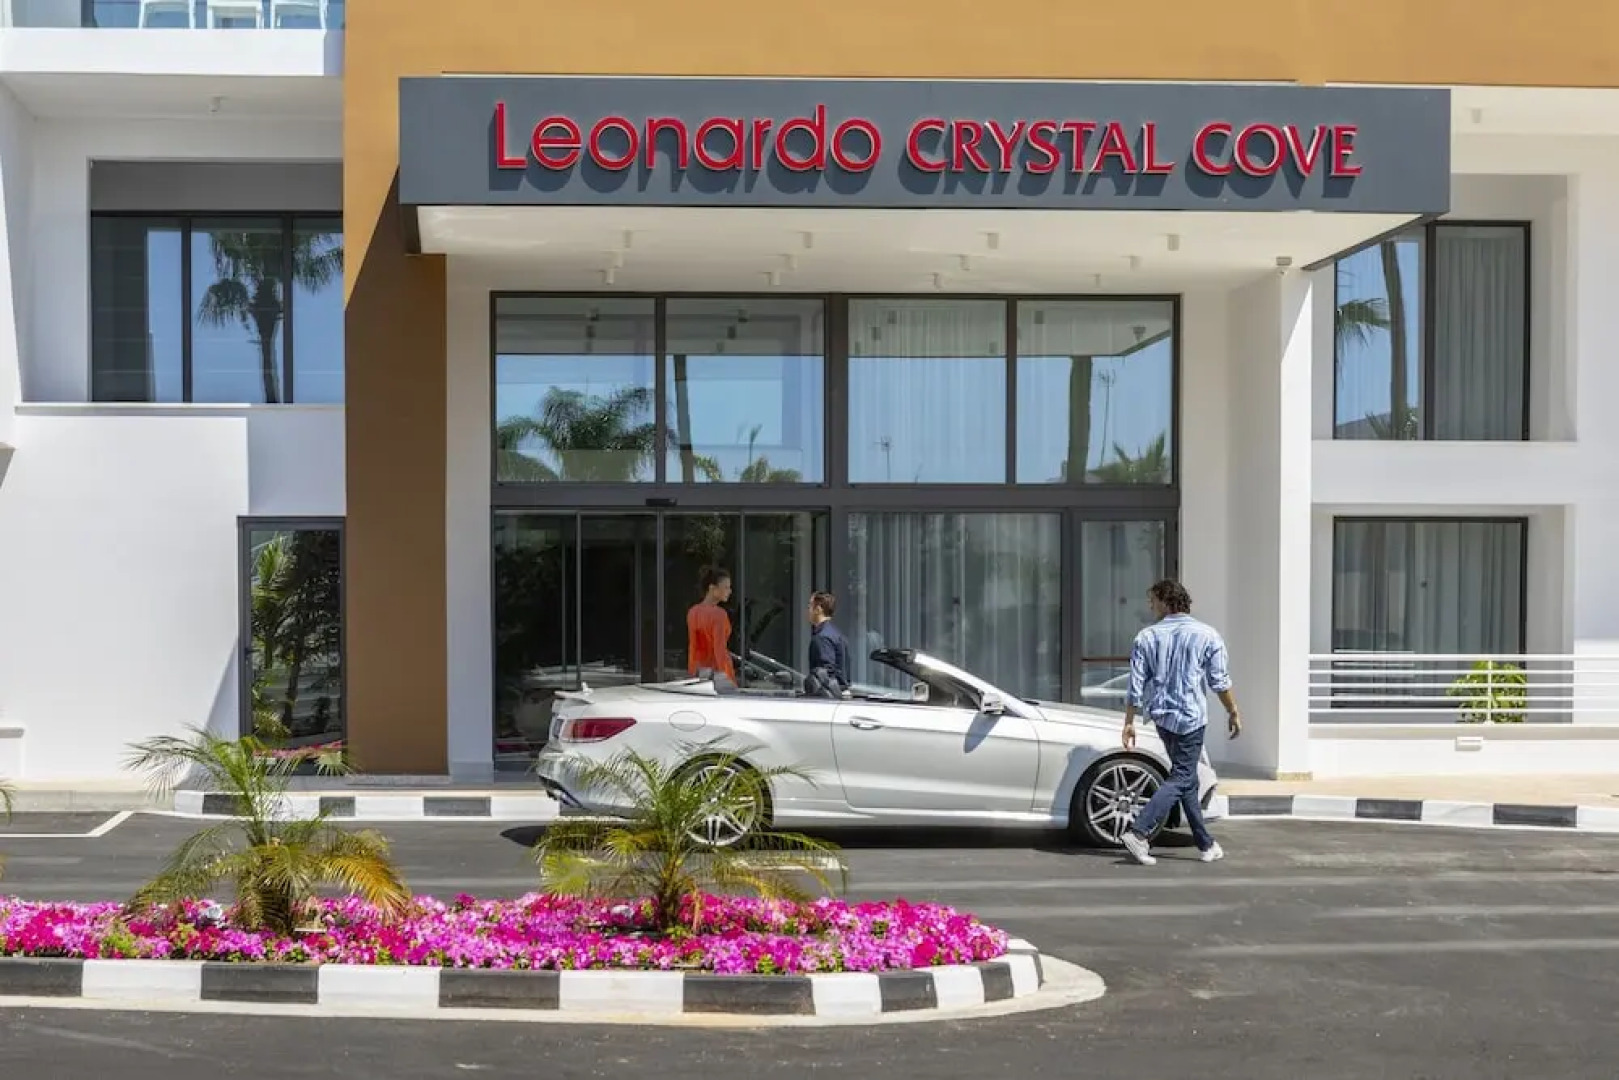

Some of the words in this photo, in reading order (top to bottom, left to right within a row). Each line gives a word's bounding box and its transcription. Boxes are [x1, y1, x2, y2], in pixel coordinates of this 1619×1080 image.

[495, 101, 883, 172] Leonardo
[906, 118, 1174, 174] CRYSTAL
[1193, 122, 1364, 177] COVE
